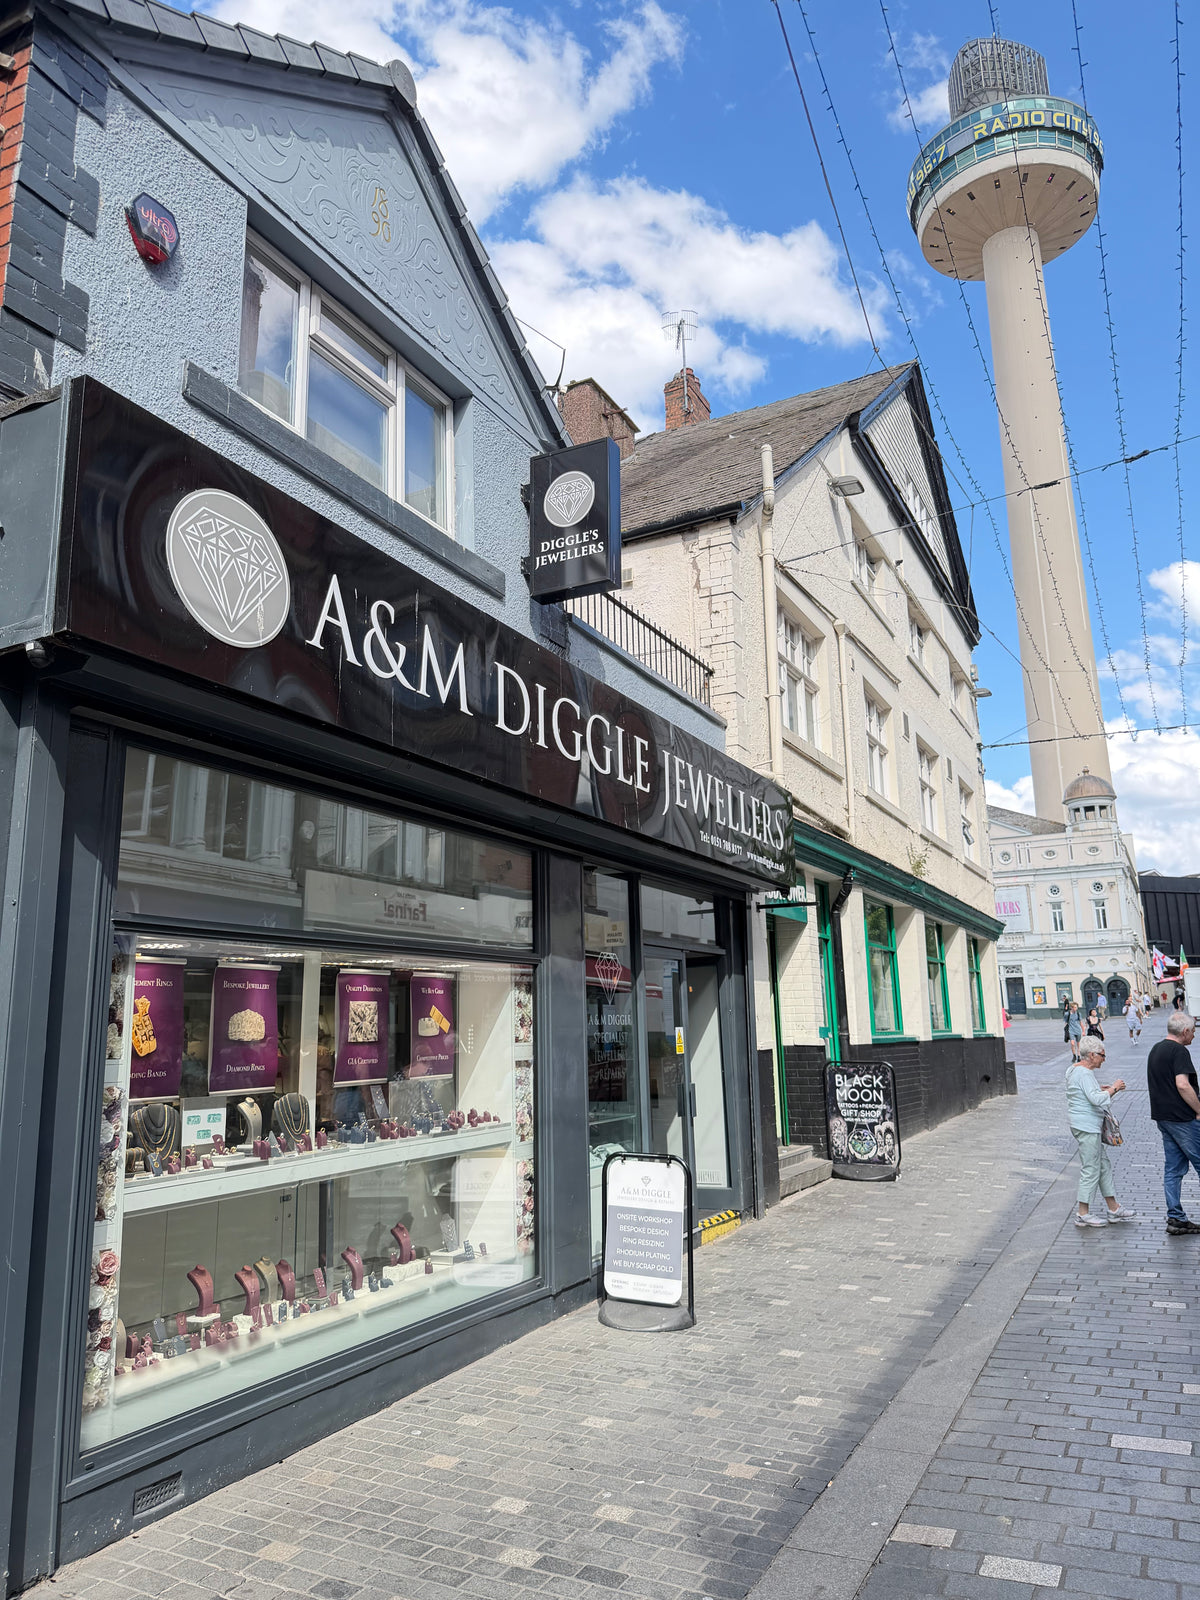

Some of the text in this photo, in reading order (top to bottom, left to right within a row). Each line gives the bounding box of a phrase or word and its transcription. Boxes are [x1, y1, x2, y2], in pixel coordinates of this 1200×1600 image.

[974, 111, 1045, 140] RADIO
[1053, 112, 1088, 137] CITY
[540, 529, 599, 553] DIGGLE'S
[535, 541, 605, 570] JEWELLERS
[305, 573, 785, 851] A&M DIGGLE JEWELLERS
[156, 978, 174, 987] RINGS
[223, 980, 246, 989] BESPOKE
[608, 1014, 632, 1026] DIGGLE
[593, 1031, 629, 1044] SPECIALIST
[147, 1069, 167, 1078] BANDS
[835, 1073, 885, 1088] BLACK
[836, 1088, 884, 1103] MOON
[841, 1109, 882, 1118] GIFT SHOP
[641, 1188, 671, 1199] DIGGLE
[616, 1212, 673, 1225] ONSITE WORKSHOP
[619, 1224, 670, 1236] BESPOKE DESIGN
[622, 1236, 665, 1248] RING RESIZING
[616, 1247, 671, 1261] RHODIUM PLATING
[612, 1258, 674, 1273] WE BUY SCRAP GOLD
